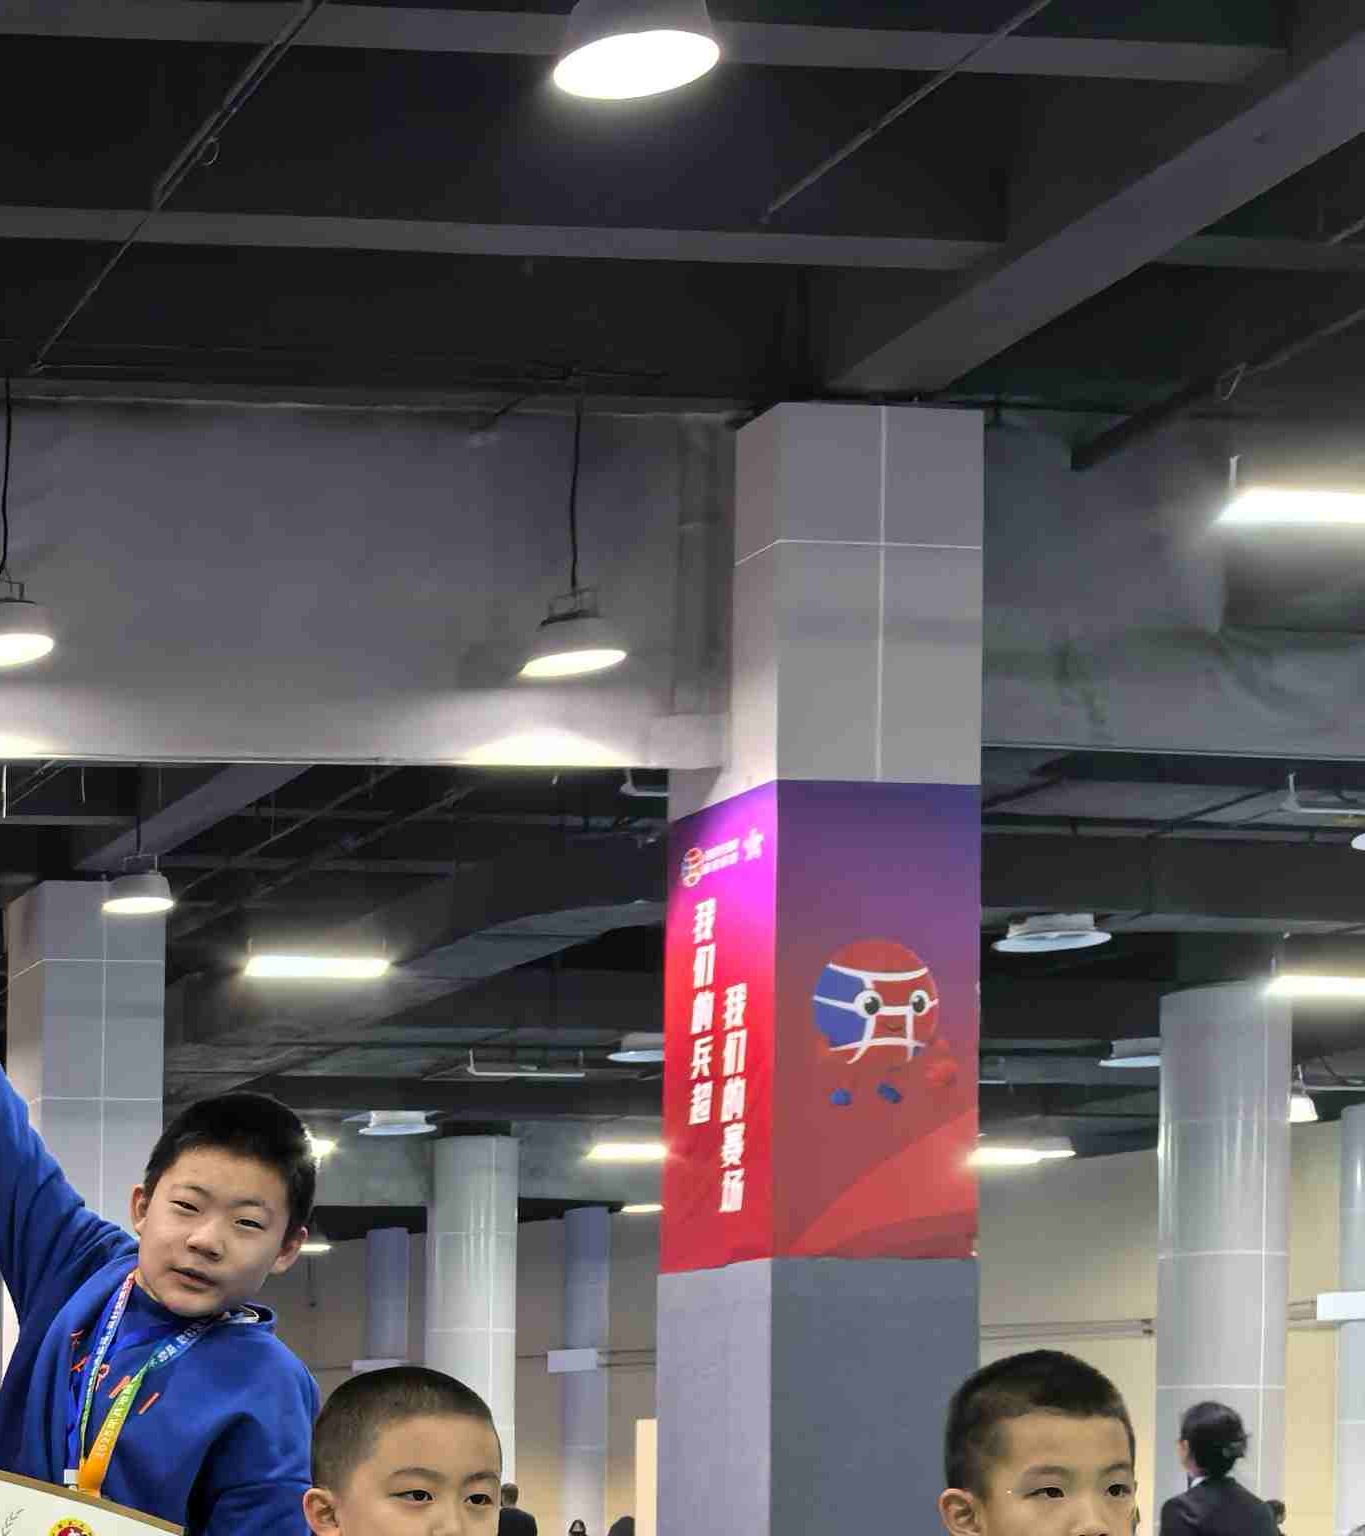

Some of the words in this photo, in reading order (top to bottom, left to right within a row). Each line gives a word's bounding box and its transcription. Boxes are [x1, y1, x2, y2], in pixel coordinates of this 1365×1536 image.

[718, 982, 747, 1214] 我们的赛场
